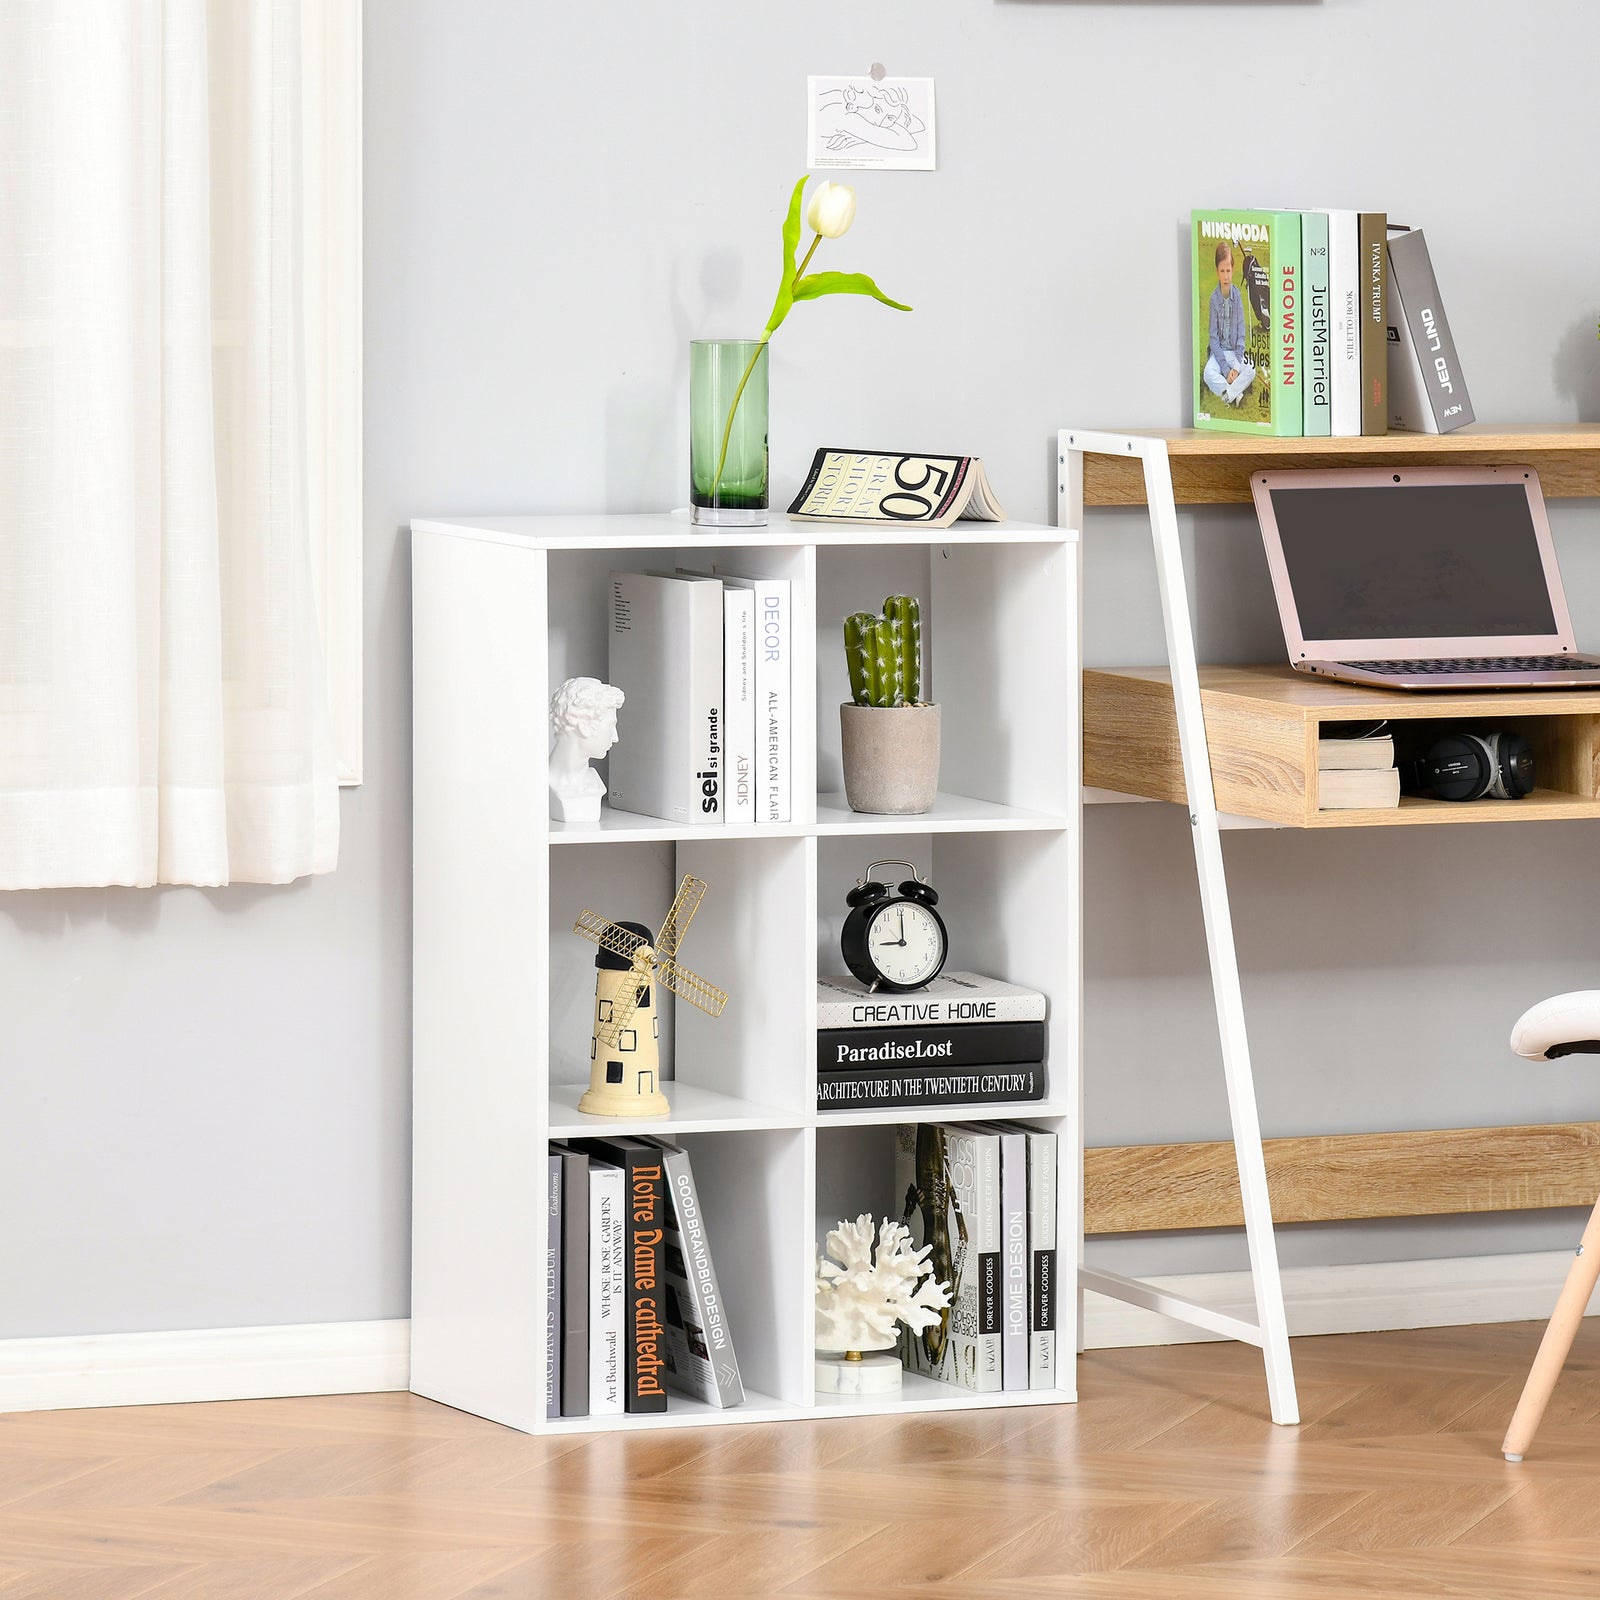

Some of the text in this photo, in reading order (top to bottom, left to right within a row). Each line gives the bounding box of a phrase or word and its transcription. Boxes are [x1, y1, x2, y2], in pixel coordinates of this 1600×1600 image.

[1201, 221, 1270, 243] NINSMODA
[1372, 243, 1382, 323] IVANKA TRUMP
[1251, 331, 1270, 350] best
[1282, 266, 1295, 386] NINSMODE
[1346, 290, 1354, 360] STILETTO BOOK
[1243, 349, 1270, 369] styles
[1312, 285, 1328, 406] JustMarried
[1420, 308, 1453, 394] JED LIND
[1444, 404, 1462, 418] NEW
[806, 454, 846, 514] STORIES
[831, 455, 868, 515] SHORT
[858, 457, 892, 517] GREAT
[879, 457, 949, 519] 50
[764, 596, 780, 662] DECOR
[697, 707, 720, 813] sei si grande
[769, 691, 779, 821] ALL-AMERICAN FLAIR
[737, 754, 748, 805] SIDNEY
[873, 924, 881, 934] 10
[883, 913, 890, 922] 11
[912, 911, 916, 921] 1
[922, 922, 928, 931] 2
[869, 939, 874, 948] 9
[922, 953, 928, 962] 4
[927, 937, 933, 946] 3
[874, 955, 880, 963] 8
[886, 965, 891, 974] 7
[899, 969, 905, 978] 6
[914, 965, 920, 974] 5
[852, 1002, 996, 1022] CREATIVE HOME
[837, 1040, 952, 1063] ParadiseLost
[891, 1078, 903, 1097] IN
[904, 1078, 923, 1096] THE
[923, 1075, 980, 1096] TWENTIETH
[981, 1073, 1026, 1093] CENTURY
[983, 1148, 992, 1182] FASHION
[1040, 1145, 1049, 1179] FASHION
[550, 1171, 559, 1216] Cloakrooms
[983, 1184, 992, 1195] OF
[984, 1196, 993, 1212] AGE
[984, 1215, 993, 1248] GOLDEN
[1041, 1212, 1049, 1245] GOLDEN
[601, 1196, 611, 1318] WHOSE ROSE GARDEN
[613, 1219, 623, 1294] IS IT ANYWAY?
[677, 1174, 697, 1218] GOOD
[704, 1294, 726, 1350] DESIGN
[1040, 1255, 1049, 1292] GODDESS
[632, 1165, 665, 1397] Notre Dame cathedral
[985, 1257, 994, 1295] GODDESS
[986, 1296, 994, 1330] FOREVER
[1009, 1284, 1023, 1336] HOME
[1041, 1293, 1049, 1327] FOREVER
[605, 1331, 617, 1403] Art Buchwald
